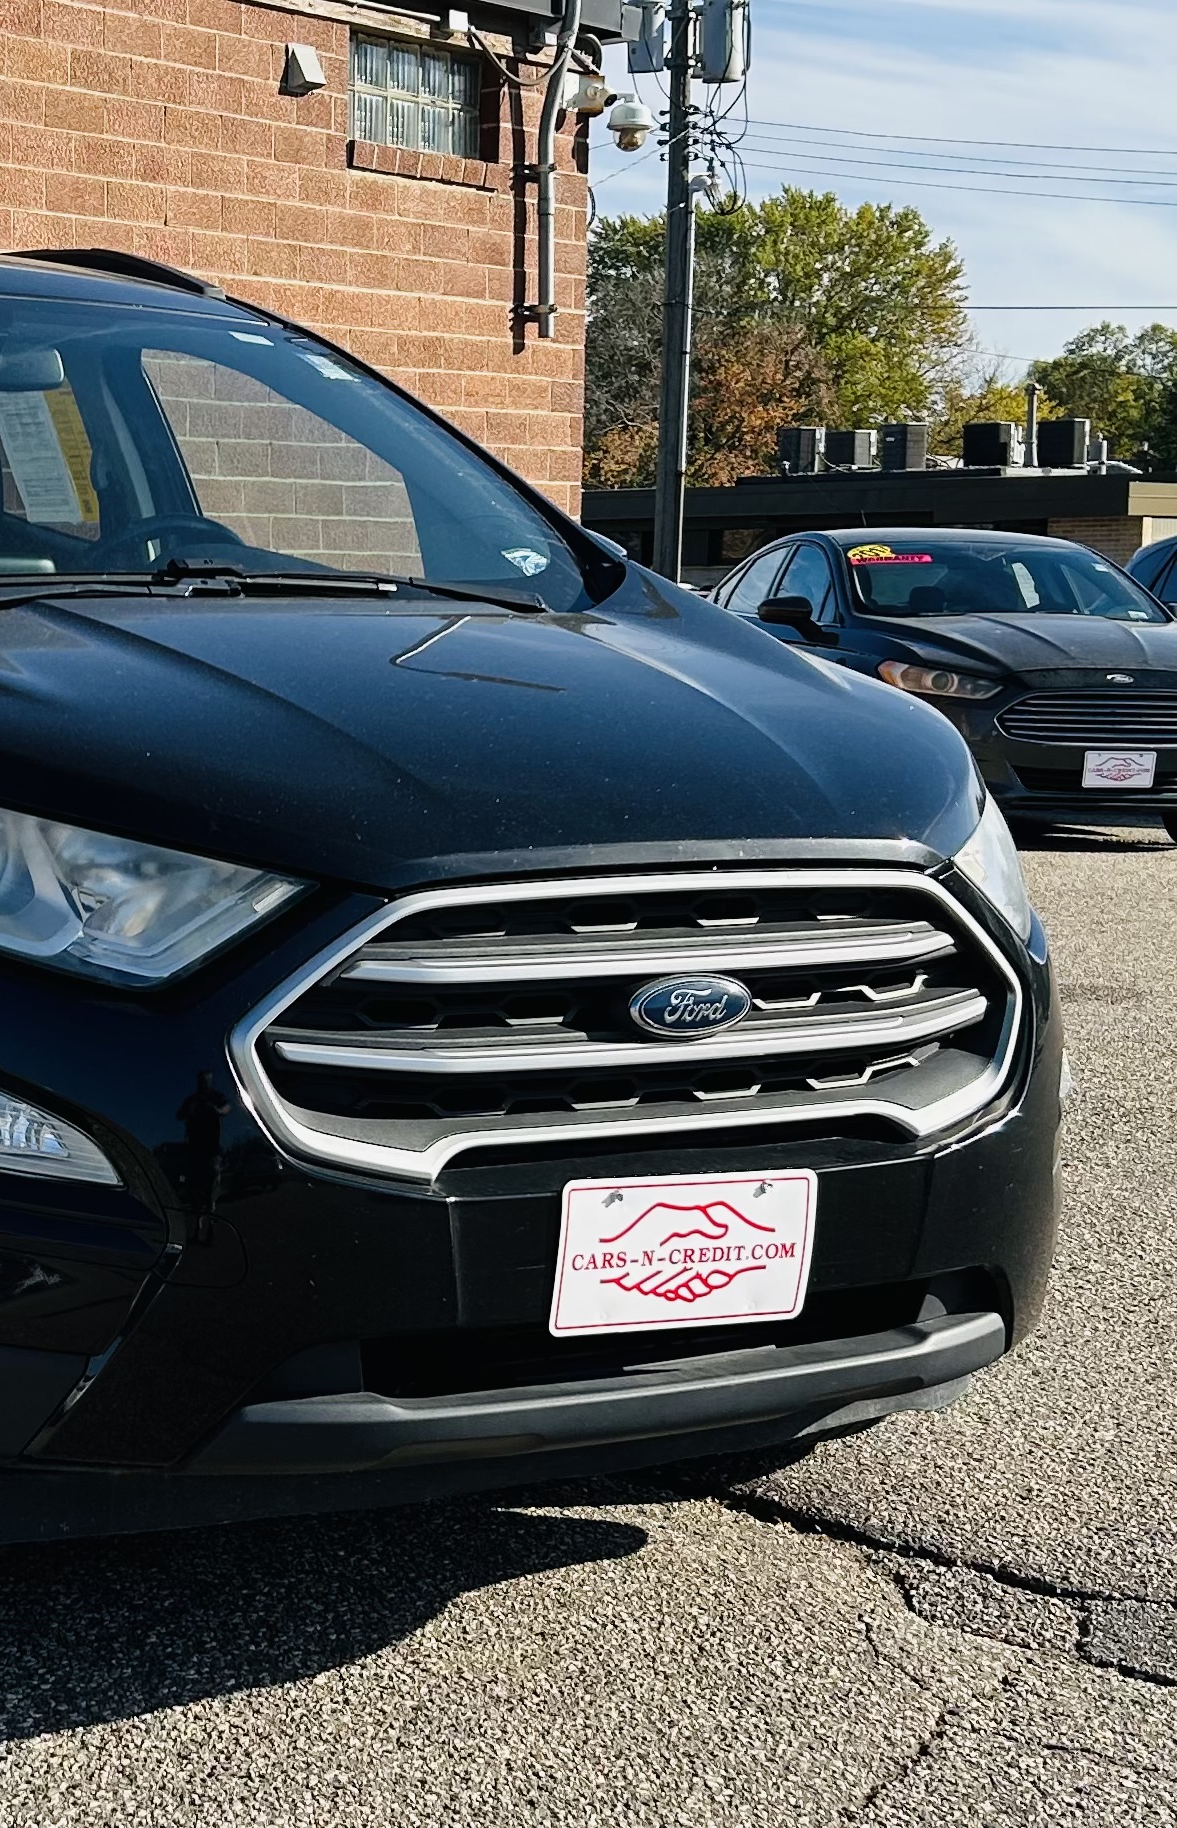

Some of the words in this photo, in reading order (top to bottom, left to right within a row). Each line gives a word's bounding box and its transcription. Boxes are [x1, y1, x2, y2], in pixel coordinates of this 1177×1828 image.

[856, 555, 925, 563] WARRANTY
[663, 988, 729, 1024] Ford
[572, 1242, 798, 1272] CARS-N-CREDIT.COM
